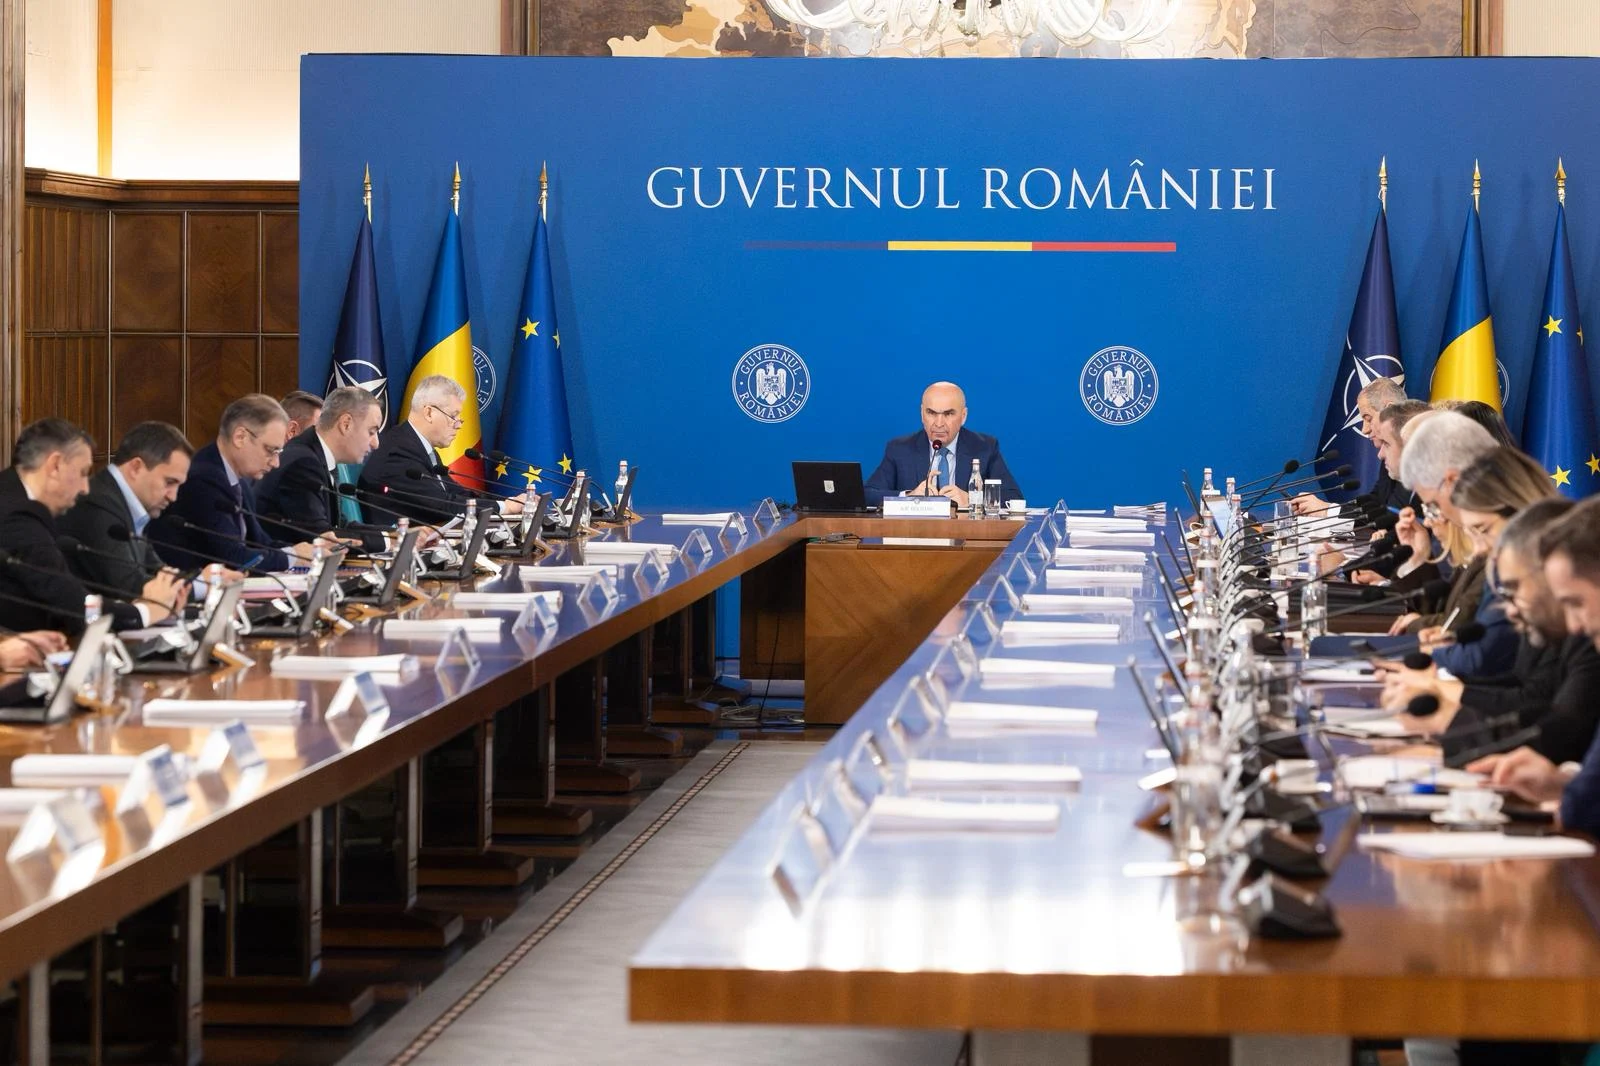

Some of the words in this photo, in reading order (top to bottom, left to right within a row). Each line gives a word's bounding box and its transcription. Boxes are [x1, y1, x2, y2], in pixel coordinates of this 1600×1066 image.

[646, 166, 961, 210] GUVERNUL
[982, 158, 1277, 211] ROMÂNIEI
[740, 349, 802, 375] GUVERNUL
[1088, 351, 1150, 377] GUVERNUL
